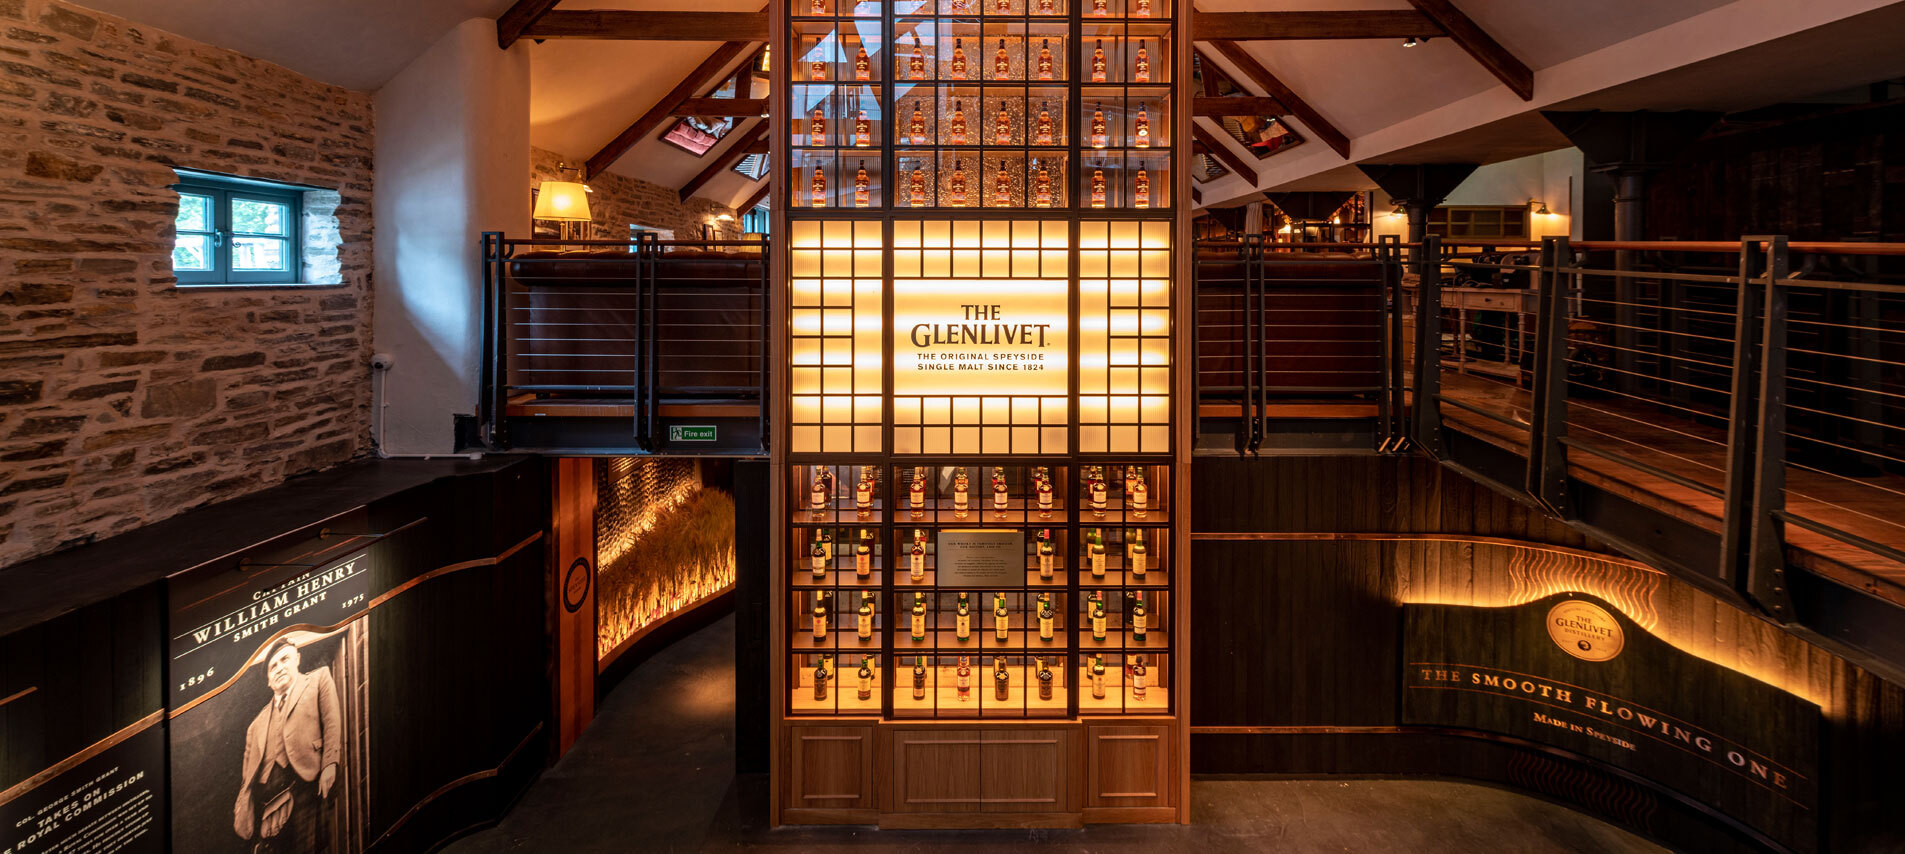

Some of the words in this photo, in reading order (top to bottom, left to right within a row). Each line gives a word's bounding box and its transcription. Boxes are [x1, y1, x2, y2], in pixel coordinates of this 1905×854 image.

[961, 304, 1000, 320] THE
[911, 324, 1049, 347] GLENLIVET
[192, 592, 288, 644] WILLIAM
[297, 562, 356, 598] HENRY
[233, 614, 279, 643] SMITH
[284, 592, 327, 618] GRANT
[342, 593, 364, 609] 1975
[1556, 618, 1613, 638] GLENLIVET
[178, 666, 214, 692] 1896
[1421, 669, 1462, 682] THE
[1472, 672, 1572, 704] SMOOTH
[1584, 696, 1712, 753] FLOWING
[1727, 751, 1788, 790] ONE
[16, 821, 60, 852] ROYAL
[64, 770, 144, 822] COMMISSION
[37, 796, 70, 816] GEORGE
[71, 780, 94, 797] SMITH
[96, 766, 119, 783] GRANT
[37, 799, 80, 828] TAKES
[83, 787, 101, 802] ON
